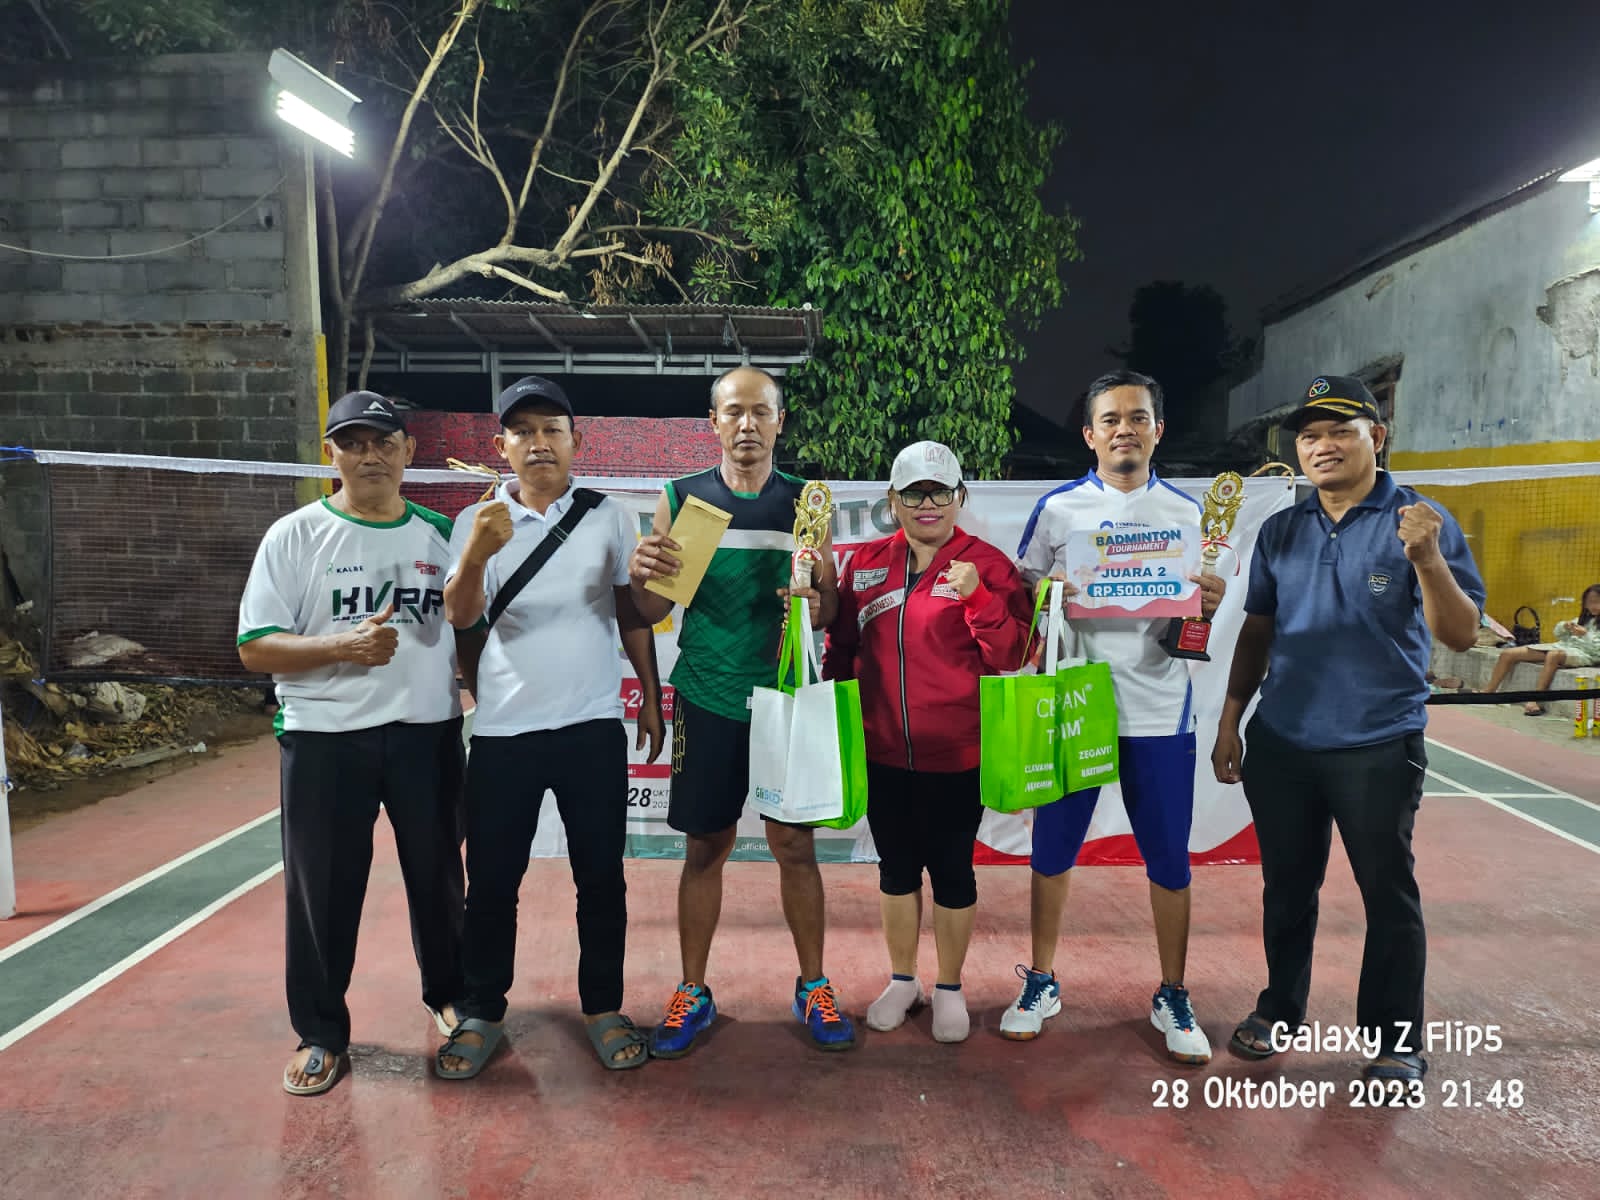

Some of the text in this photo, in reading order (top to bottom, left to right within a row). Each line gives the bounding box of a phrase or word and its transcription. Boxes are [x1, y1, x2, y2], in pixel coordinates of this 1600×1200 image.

[1096, 529, 1181, 546] BADMINTON
[1111, 541, 1165, 553] TOURNAMENT
[1101, 566, 1167, 579] JUARA 2
[1093, 584, 1175, 597] RP.500.000
